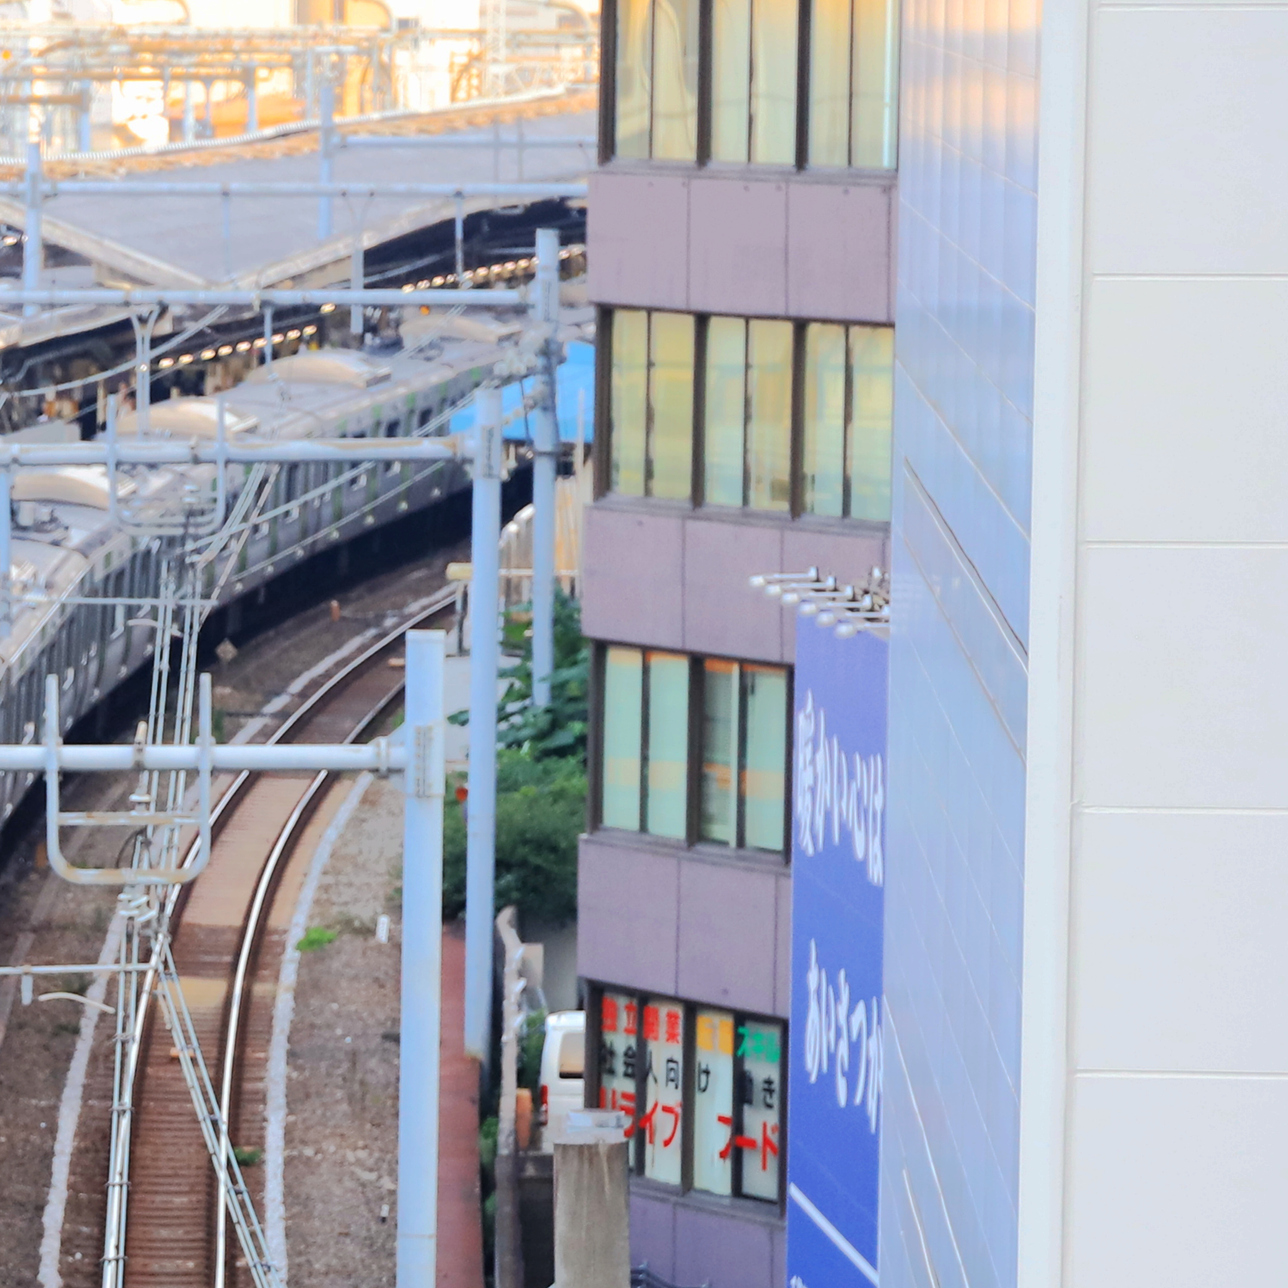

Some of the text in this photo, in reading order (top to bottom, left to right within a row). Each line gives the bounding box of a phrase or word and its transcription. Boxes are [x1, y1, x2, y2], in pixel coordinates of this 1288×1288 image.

[797, 688, 883, 887] 暖かい心は
